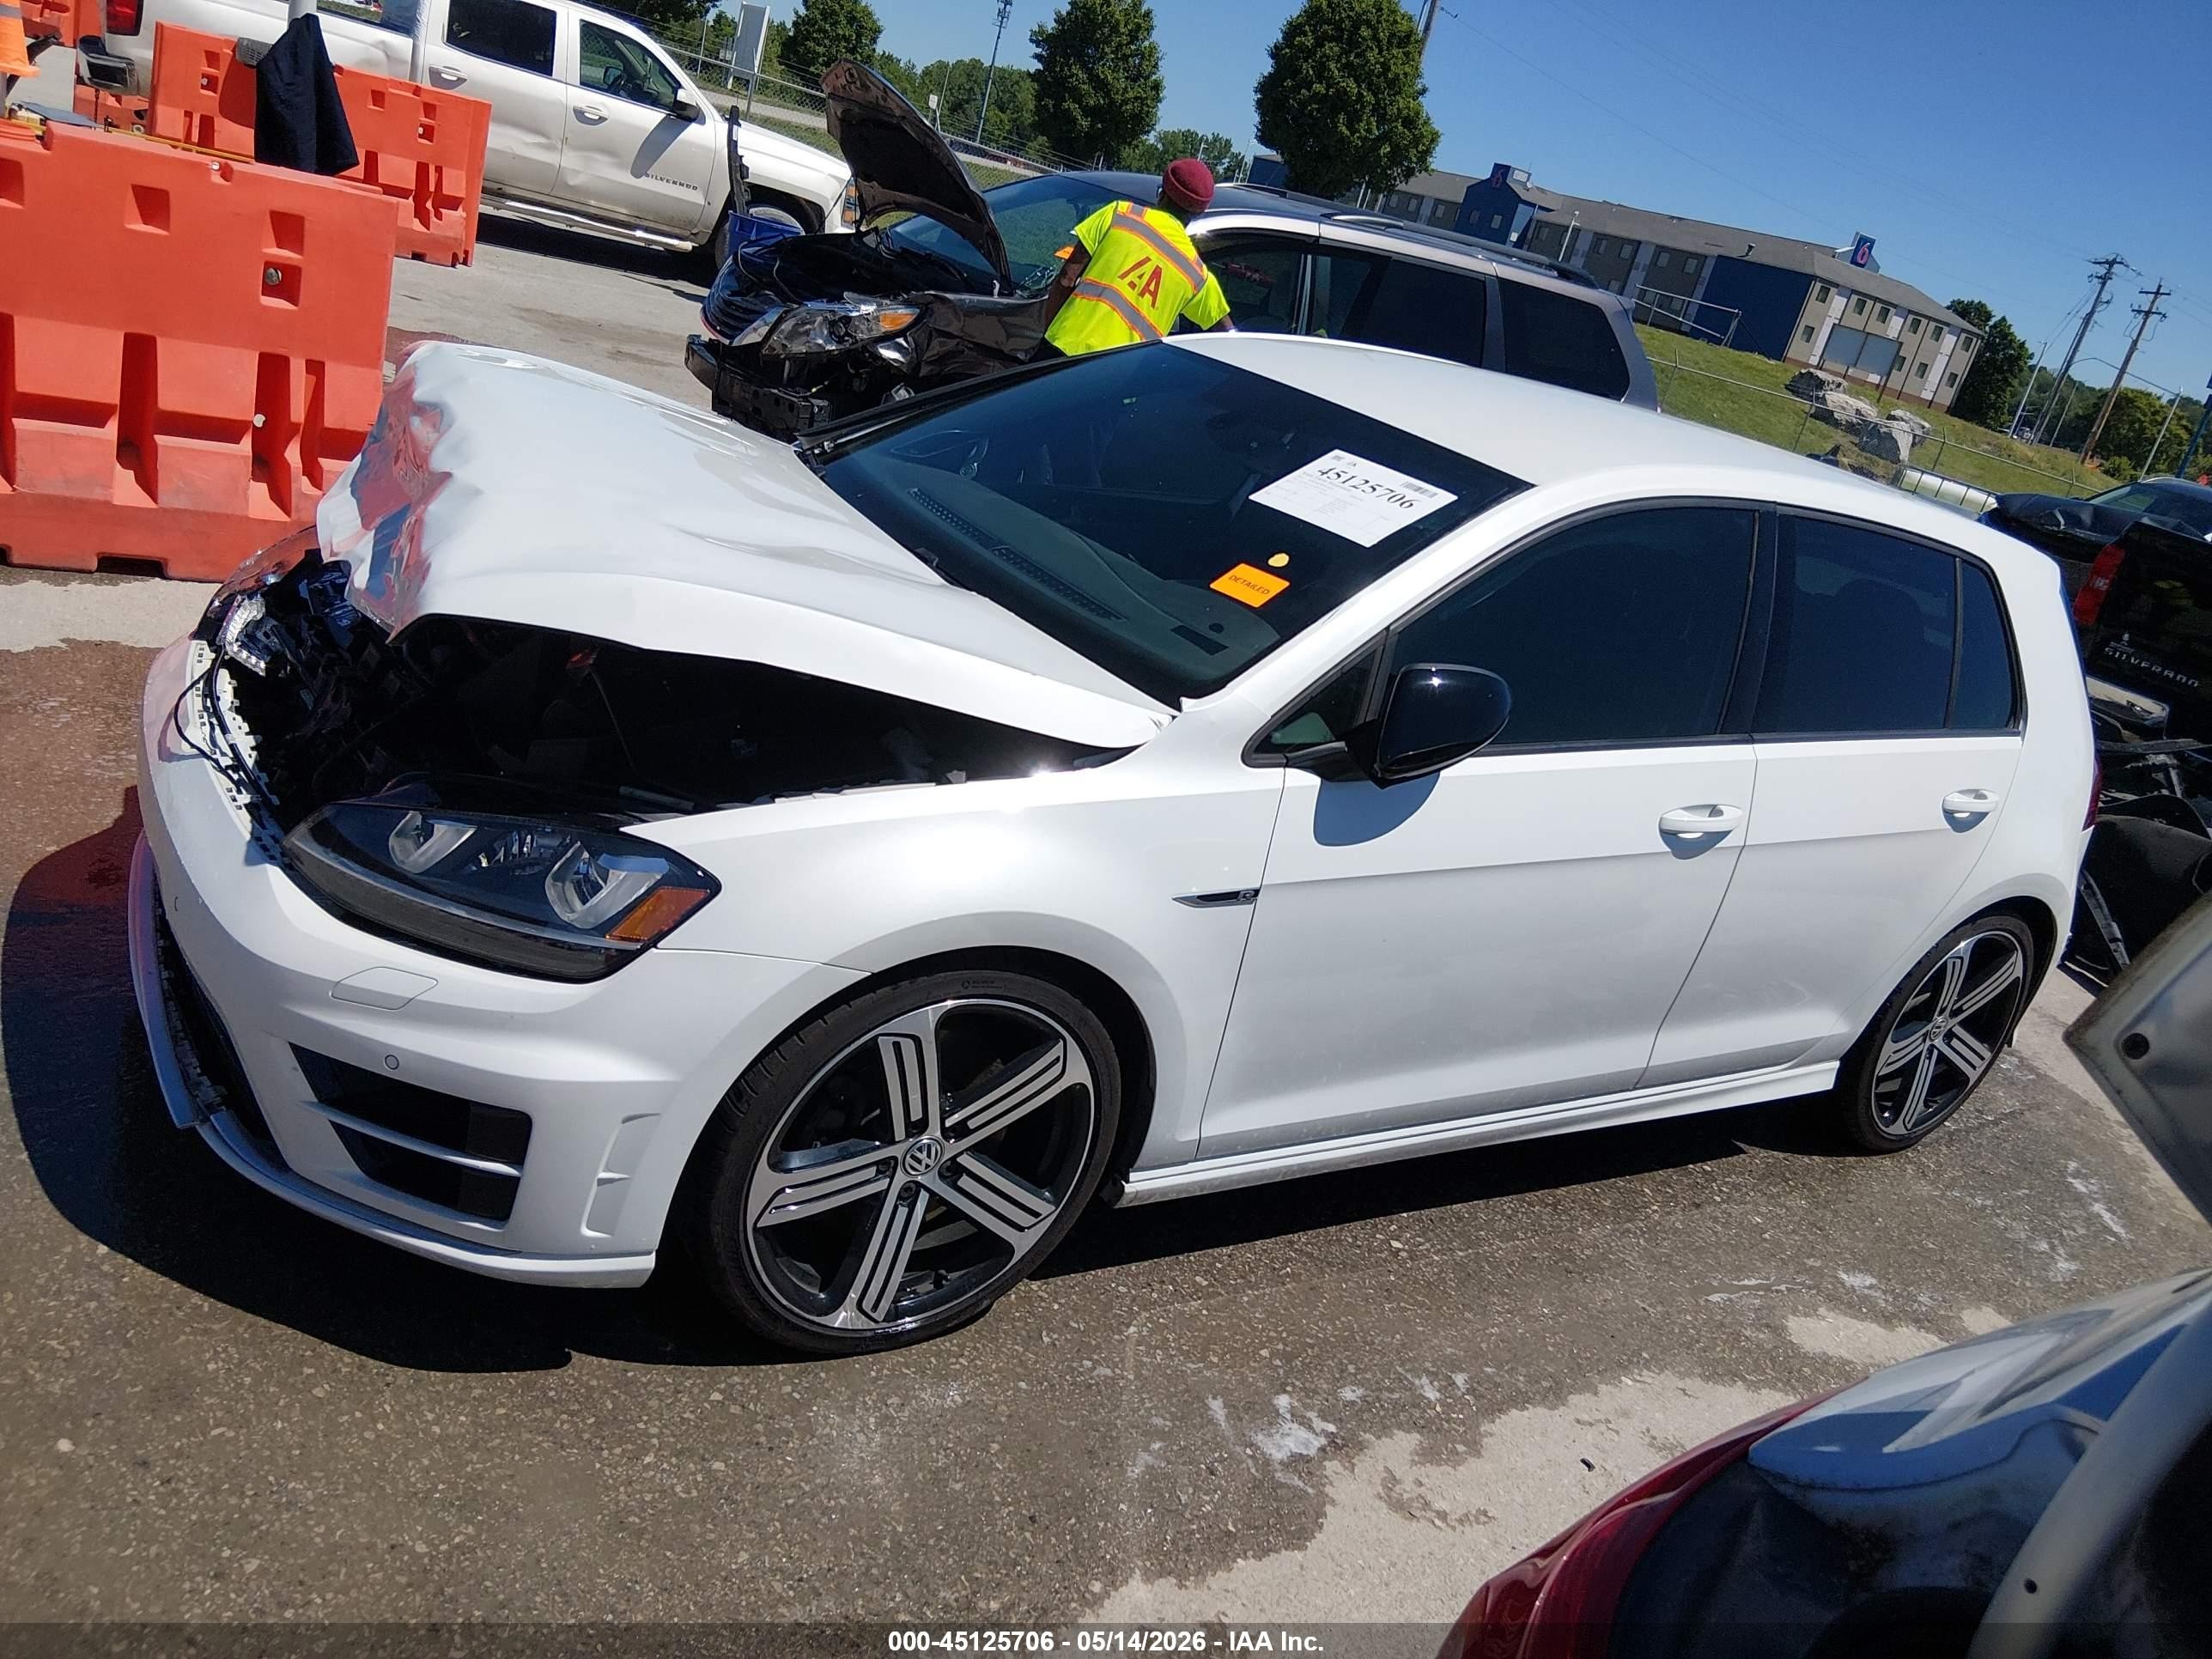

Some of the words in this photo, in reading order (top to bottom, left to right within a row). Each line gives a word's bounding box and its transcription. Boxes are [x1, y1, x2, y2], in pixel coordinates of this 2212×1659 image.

[1857, 242, 1869, 264] 6
[1317, 467, 1422, 509] 45125706
[1229, 574, 1270, 595] DETAILED
[2104, 647, 2198, 688] SILVERADO
